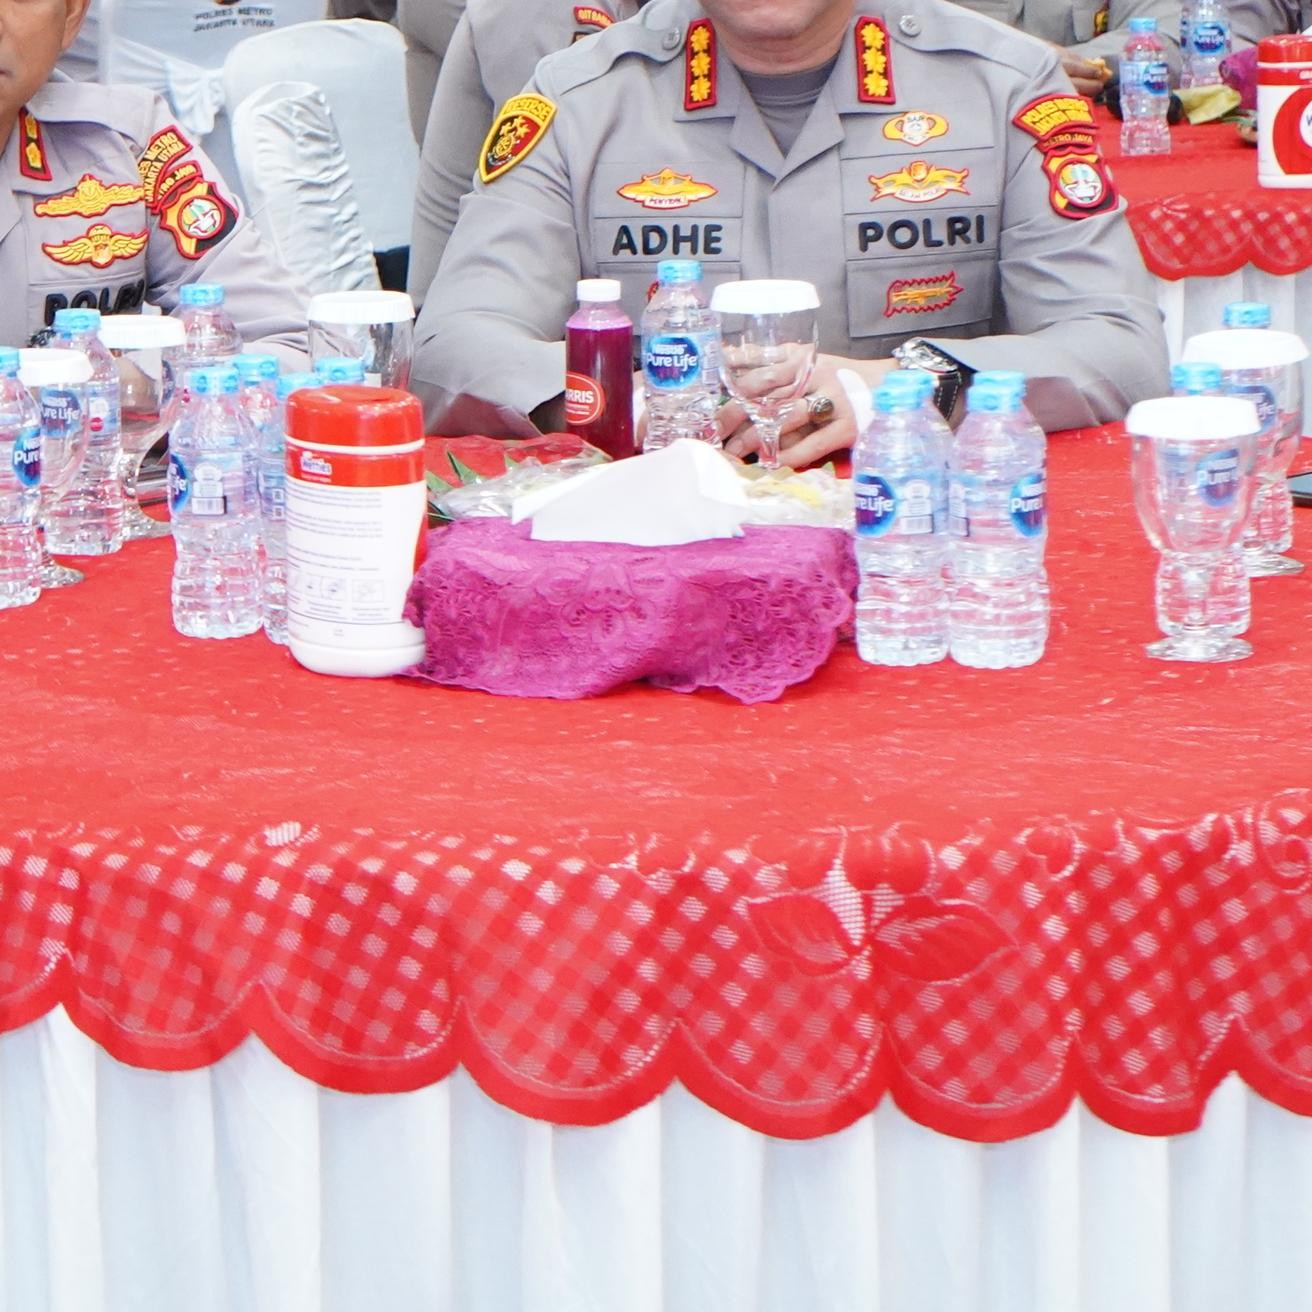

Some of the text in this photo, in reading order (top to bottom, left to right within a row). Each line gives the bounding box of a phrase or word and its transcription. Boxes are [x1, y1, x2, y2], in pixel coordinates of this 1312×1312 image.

[611, 223, 724, 257] ADHE
[858, 214, 986, 253] POLRI
[647, 353, 698, 372] Pure Life
[868, 496, 894, 517] Life
